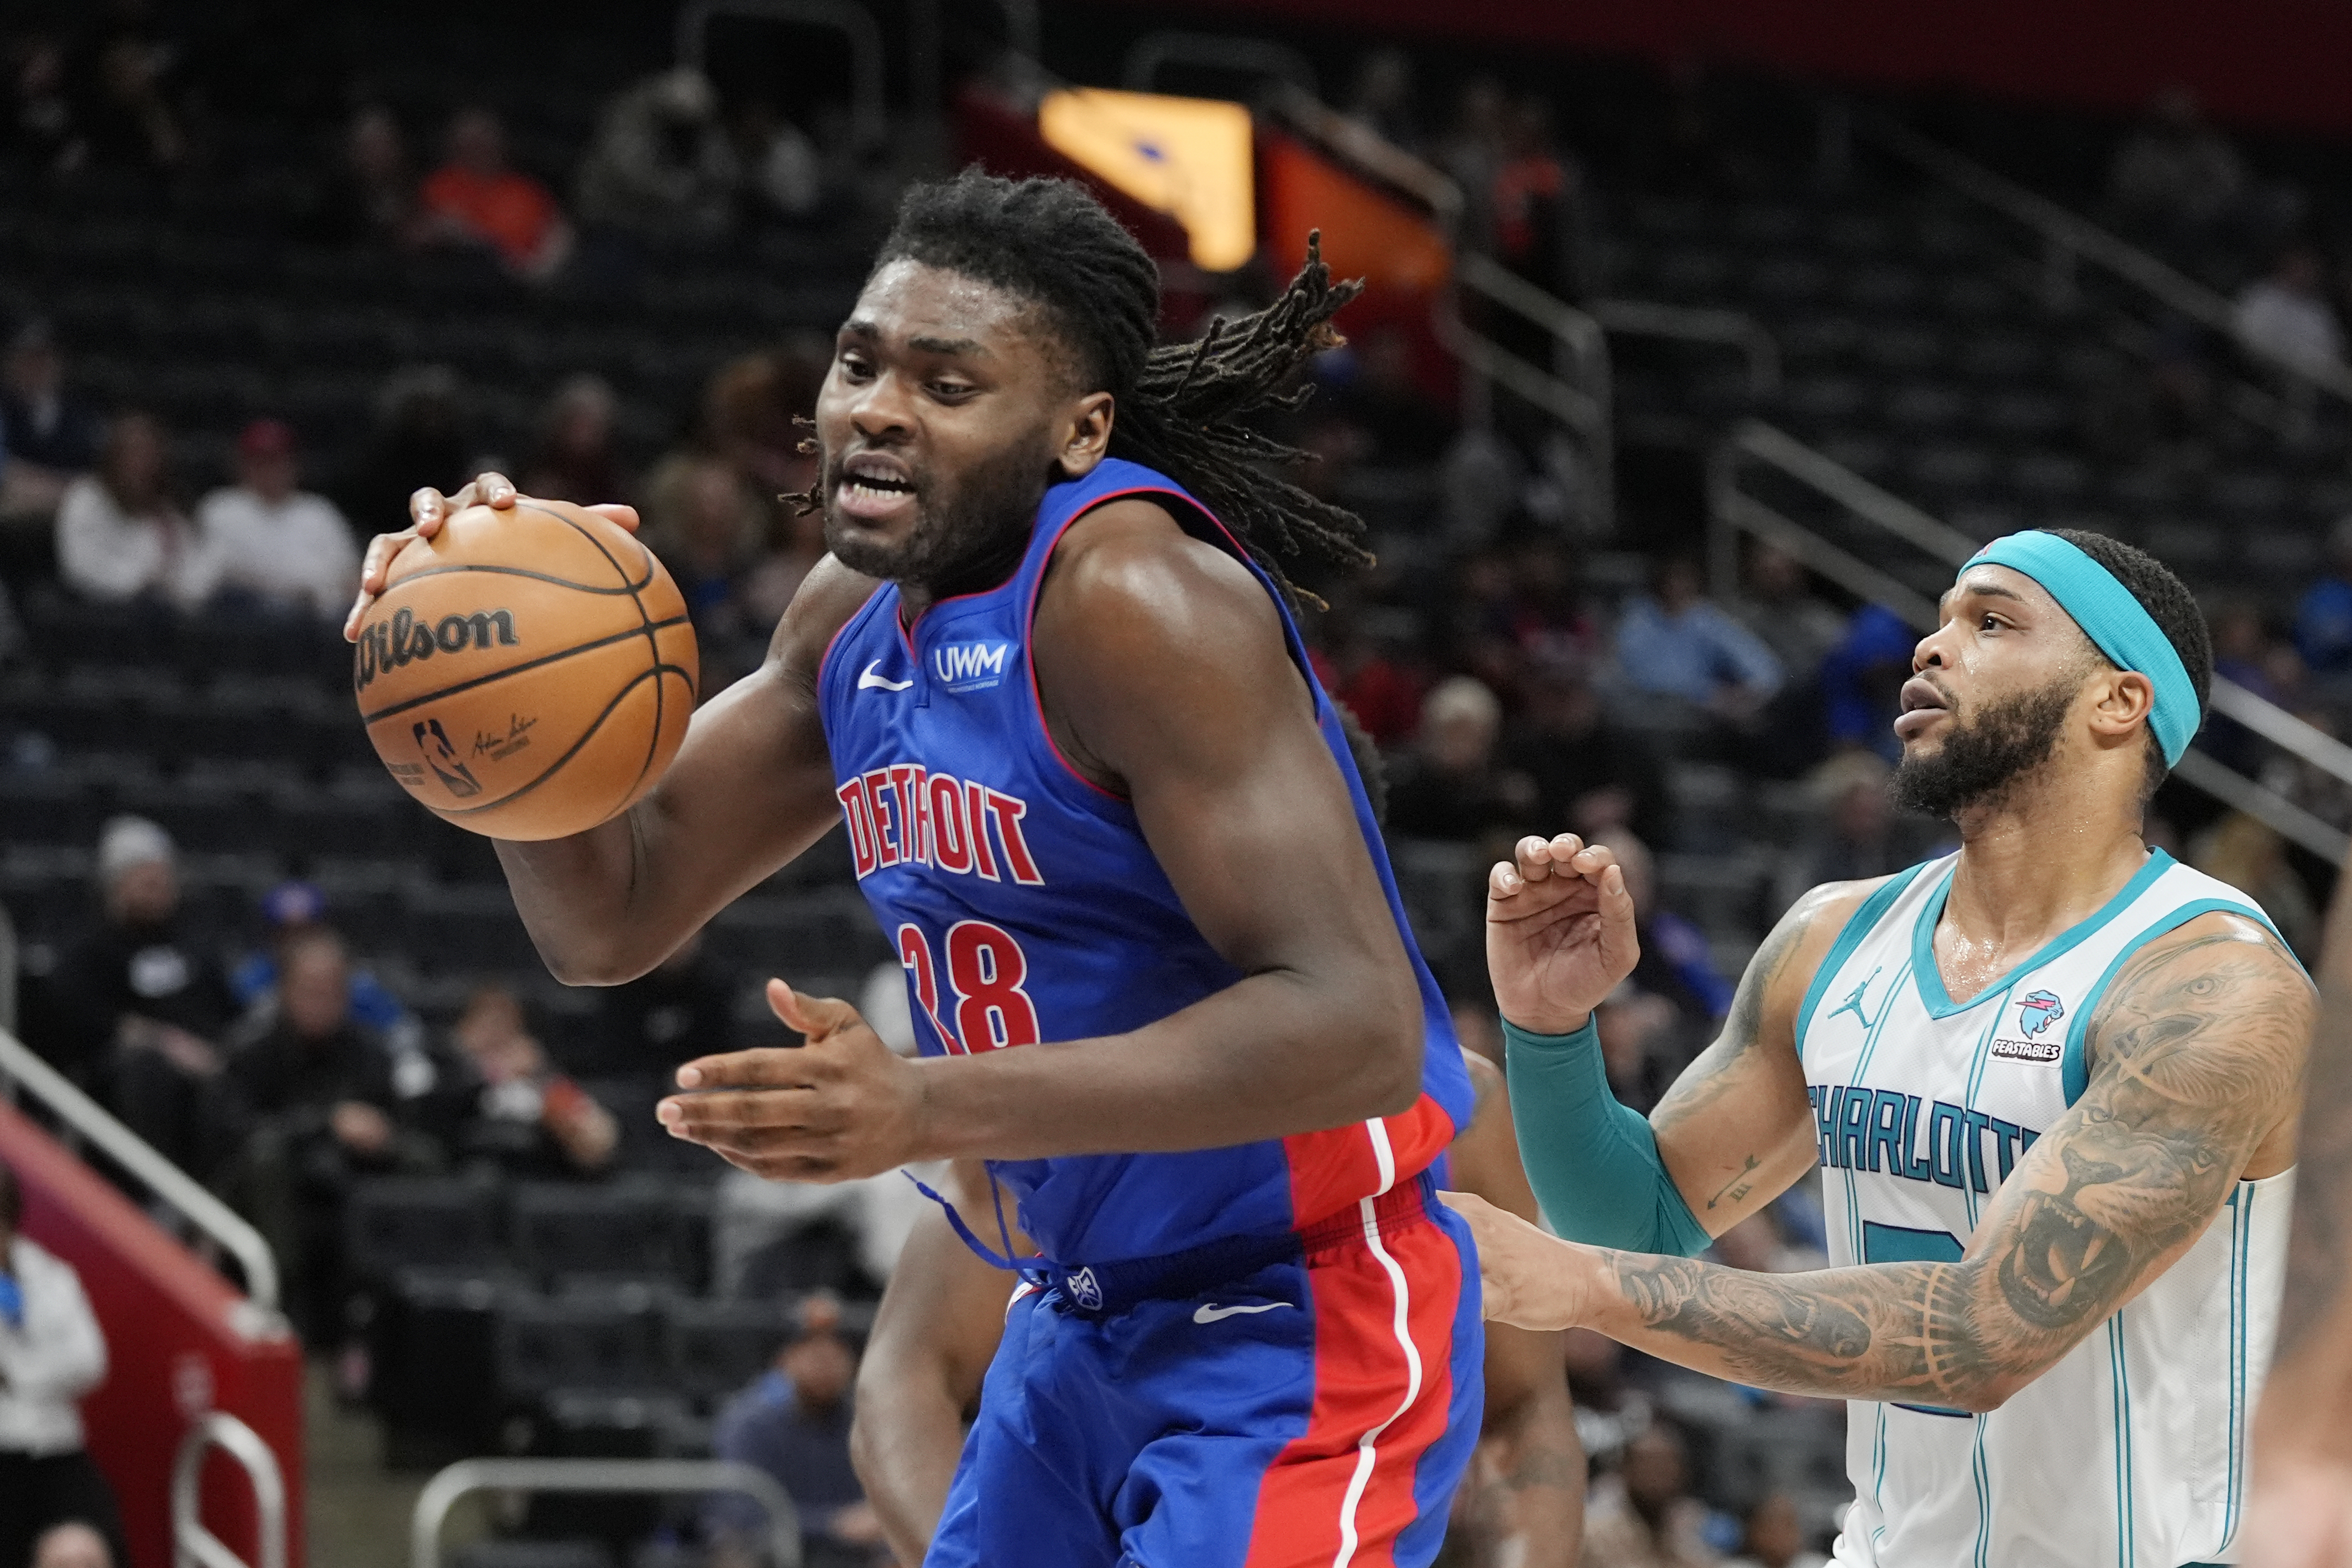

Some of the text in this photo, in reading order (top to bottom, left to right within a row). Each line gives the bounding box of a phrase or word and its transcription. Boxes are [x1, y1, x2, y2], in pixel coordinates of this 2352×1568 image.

[935, 643, 1007, 682] UWM
[836, 763, 1045, 885] DETROIT
[1992, 1039, 2060, 1061] FEASTABLES
[1807, 1085, 2042, 1194] HARLOTT
